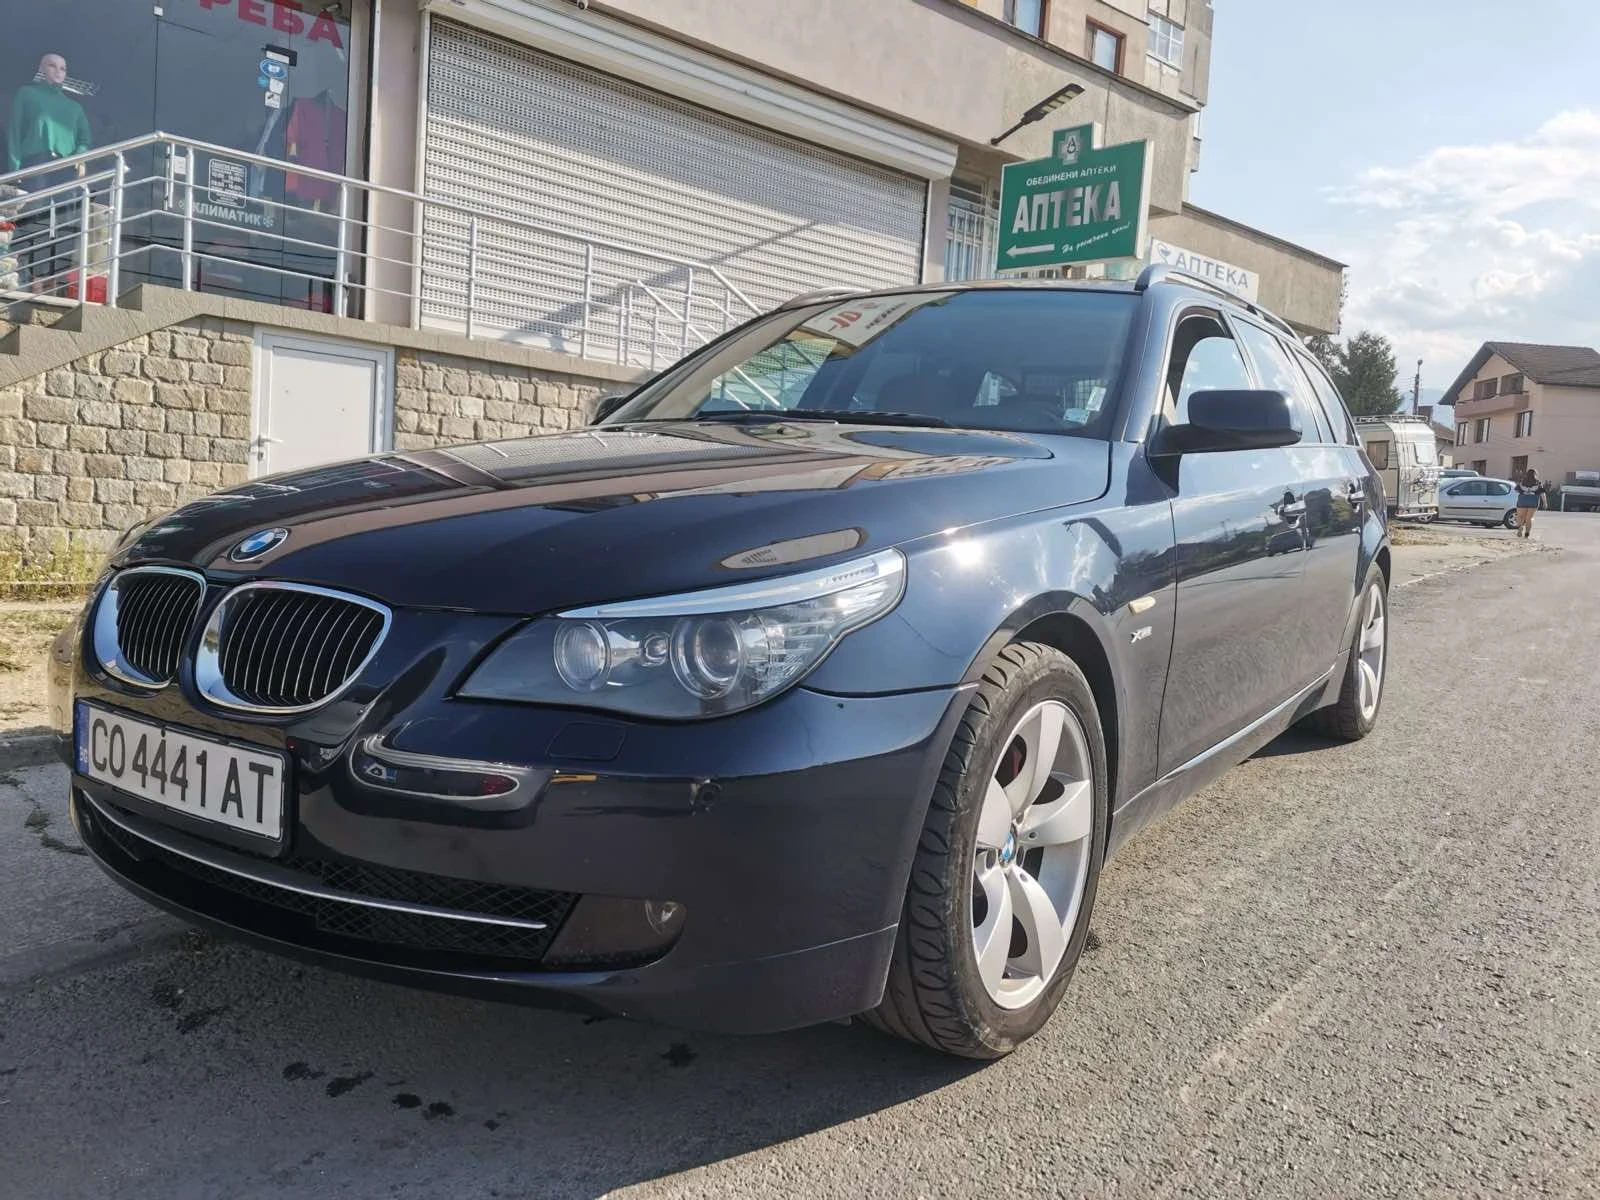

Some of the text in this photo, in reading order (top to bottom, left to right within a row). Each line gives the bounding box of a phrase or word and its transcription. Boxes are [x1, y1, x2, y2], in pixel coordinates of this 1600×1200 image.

[1026, 165, 1117, 187] ОБЕДИНЕНИ АПТЕКИ
[193, 202, 260, 227] КЛИМАТИК
[1011, 181, 1121, 234] АПТЕКА
[1175, 252, 1249, 289] АПТЕКА
[92, 718, 274, 824] CO 4441 AT
